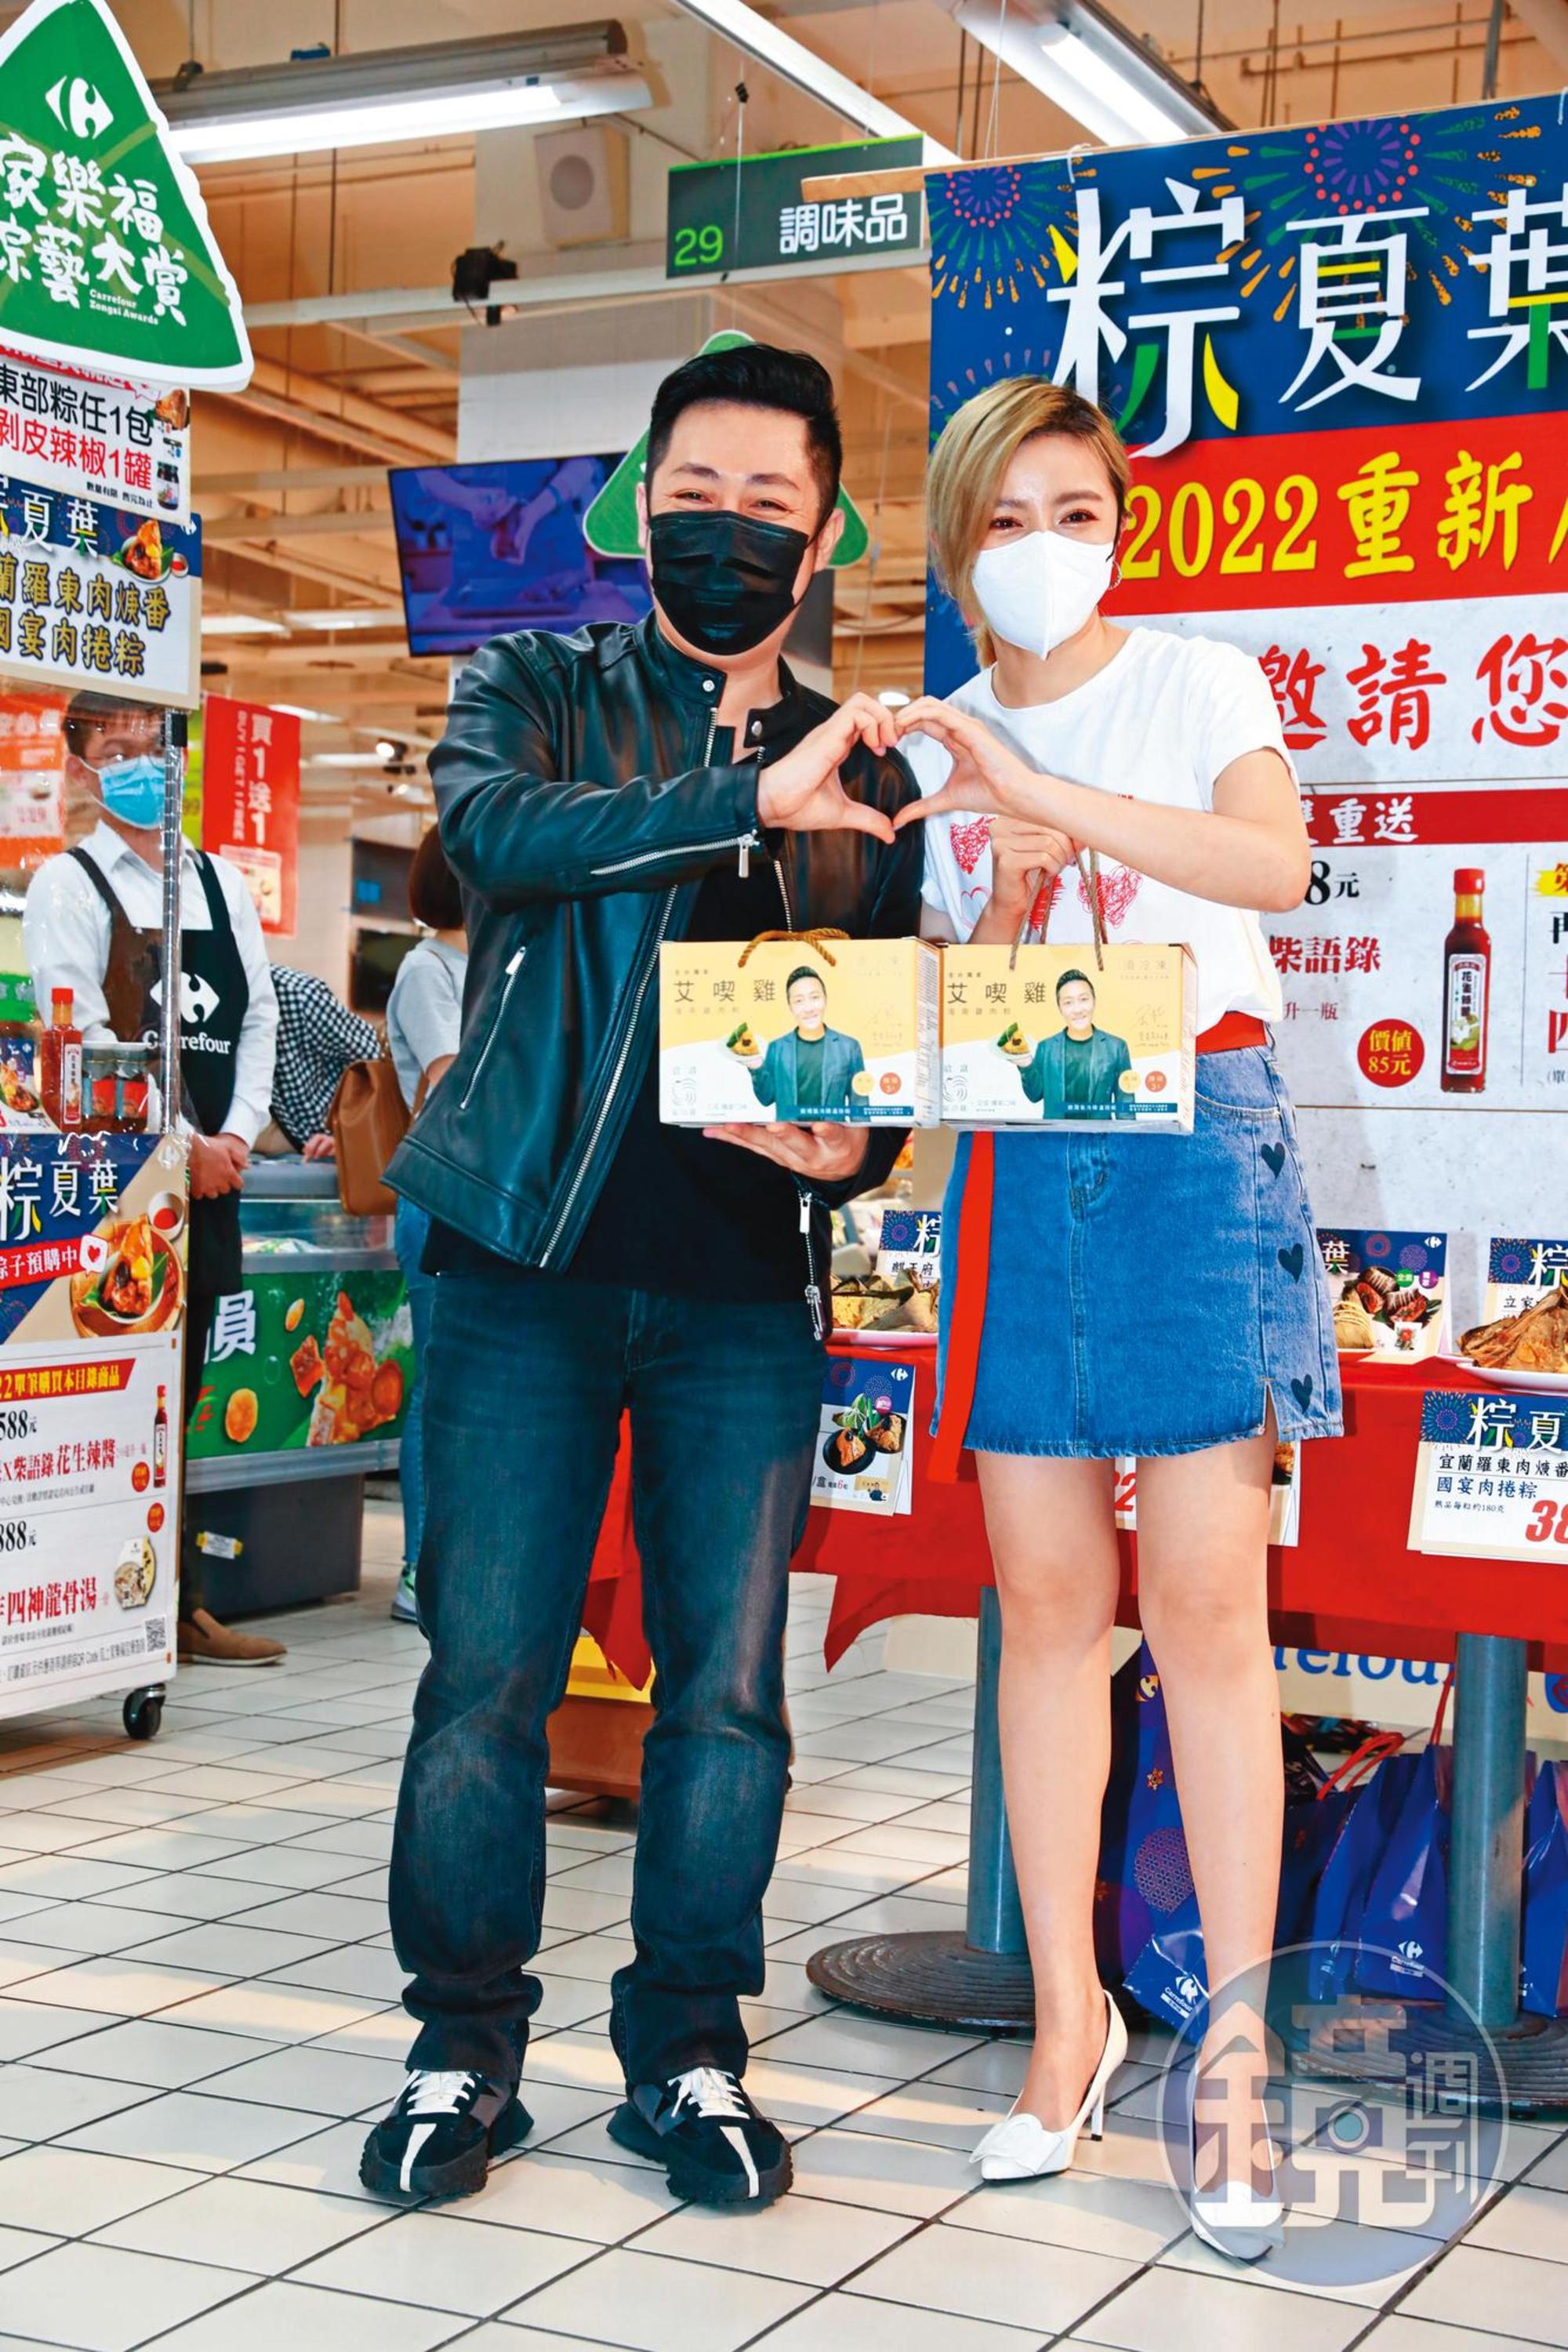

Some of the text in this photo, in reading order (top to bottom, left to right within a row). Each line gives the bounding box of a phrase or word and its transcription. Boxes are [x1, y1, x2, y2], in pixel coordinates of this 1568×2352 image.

[779, 193, 908, 253] 調味品
[675, 225, 723, 266] 29
[89, 289, 137, 308] Carrefour
[123, 308, 159, 325] Awards
[0, 474, 99, 558] 夏葉
[142, 1029, 231, 1054] Crefour
[1369, 1029, 1412, 1052] 價值
[1368, 1054, 1412, 1076] 85元
[1436, 1475, 1538, 1500] 國宴肉捲粽
[0, 1576, 98, 1626] 四神龍骨湯
